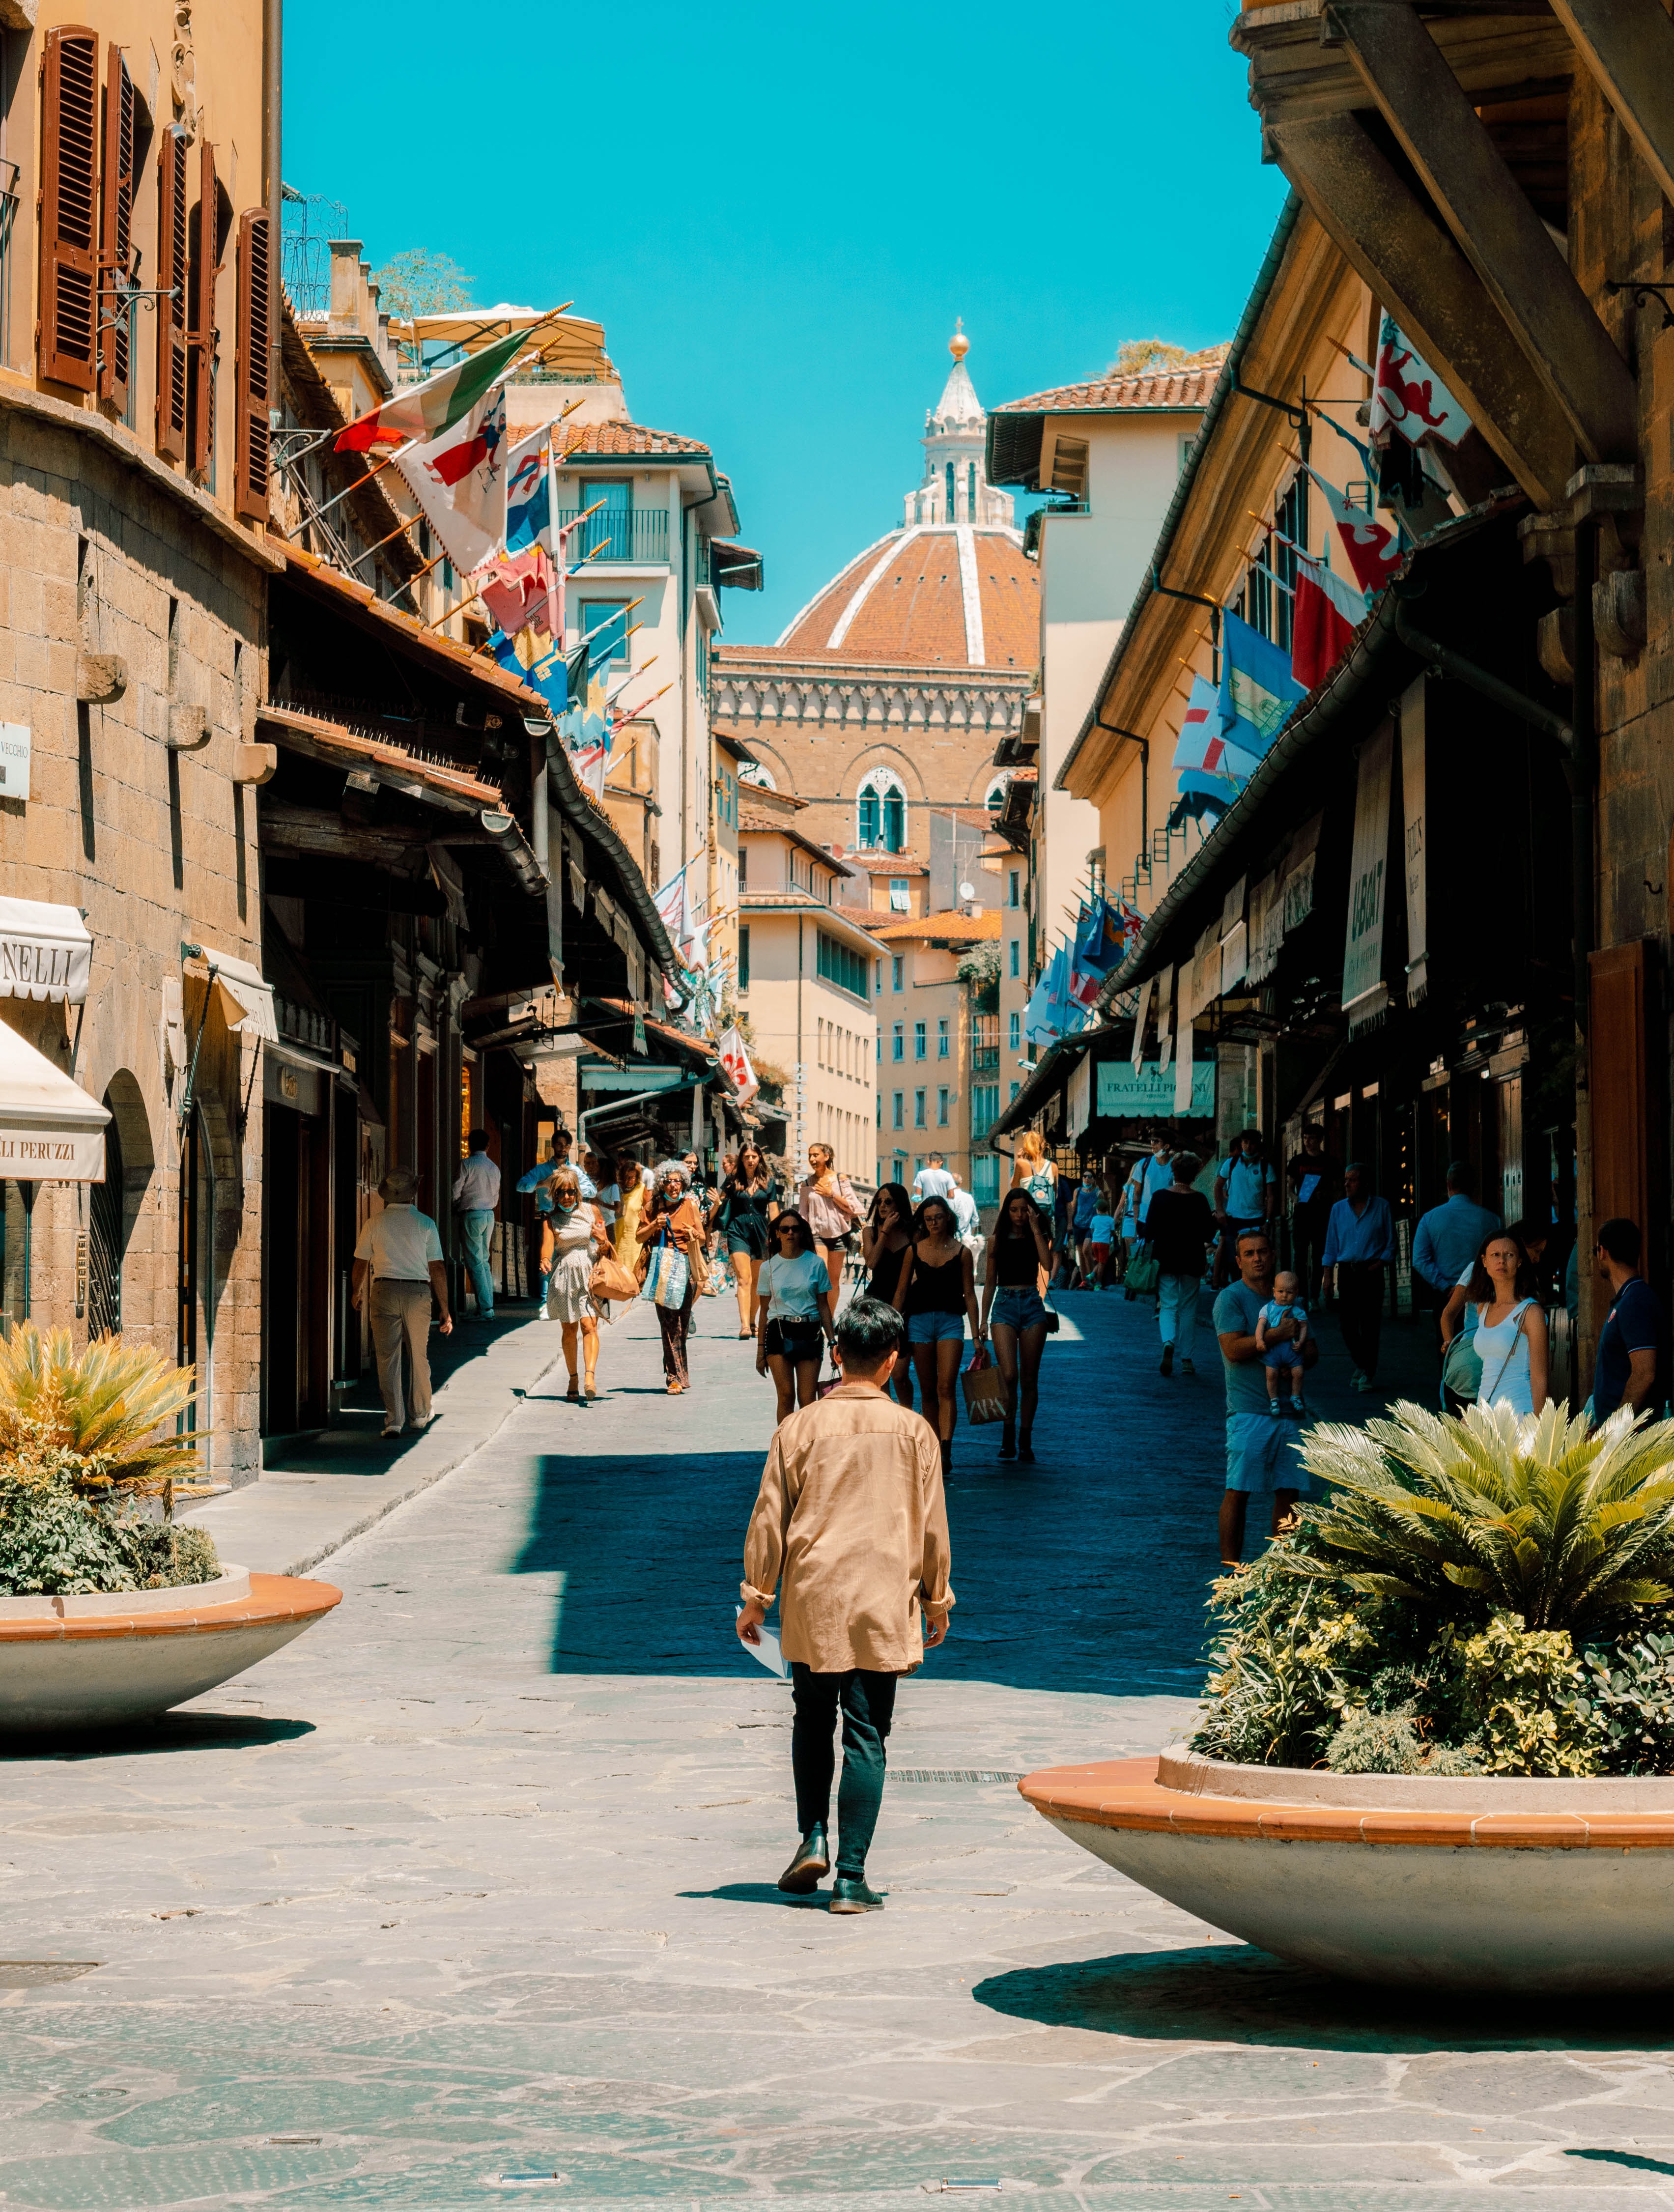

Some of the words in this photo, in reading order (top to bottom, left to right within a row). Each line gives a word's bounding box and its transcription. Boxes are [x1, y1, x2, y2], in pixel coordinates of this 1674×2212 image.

[1, 741, 28, 758] VECCHIO
[2, 942, 73, 987] NELLI
[1107, 1083, 1161, 1092] FRATELLI
[0, 1141, 15, 1158] LI
[20, 1142, 75, 1160] PERUZZI
